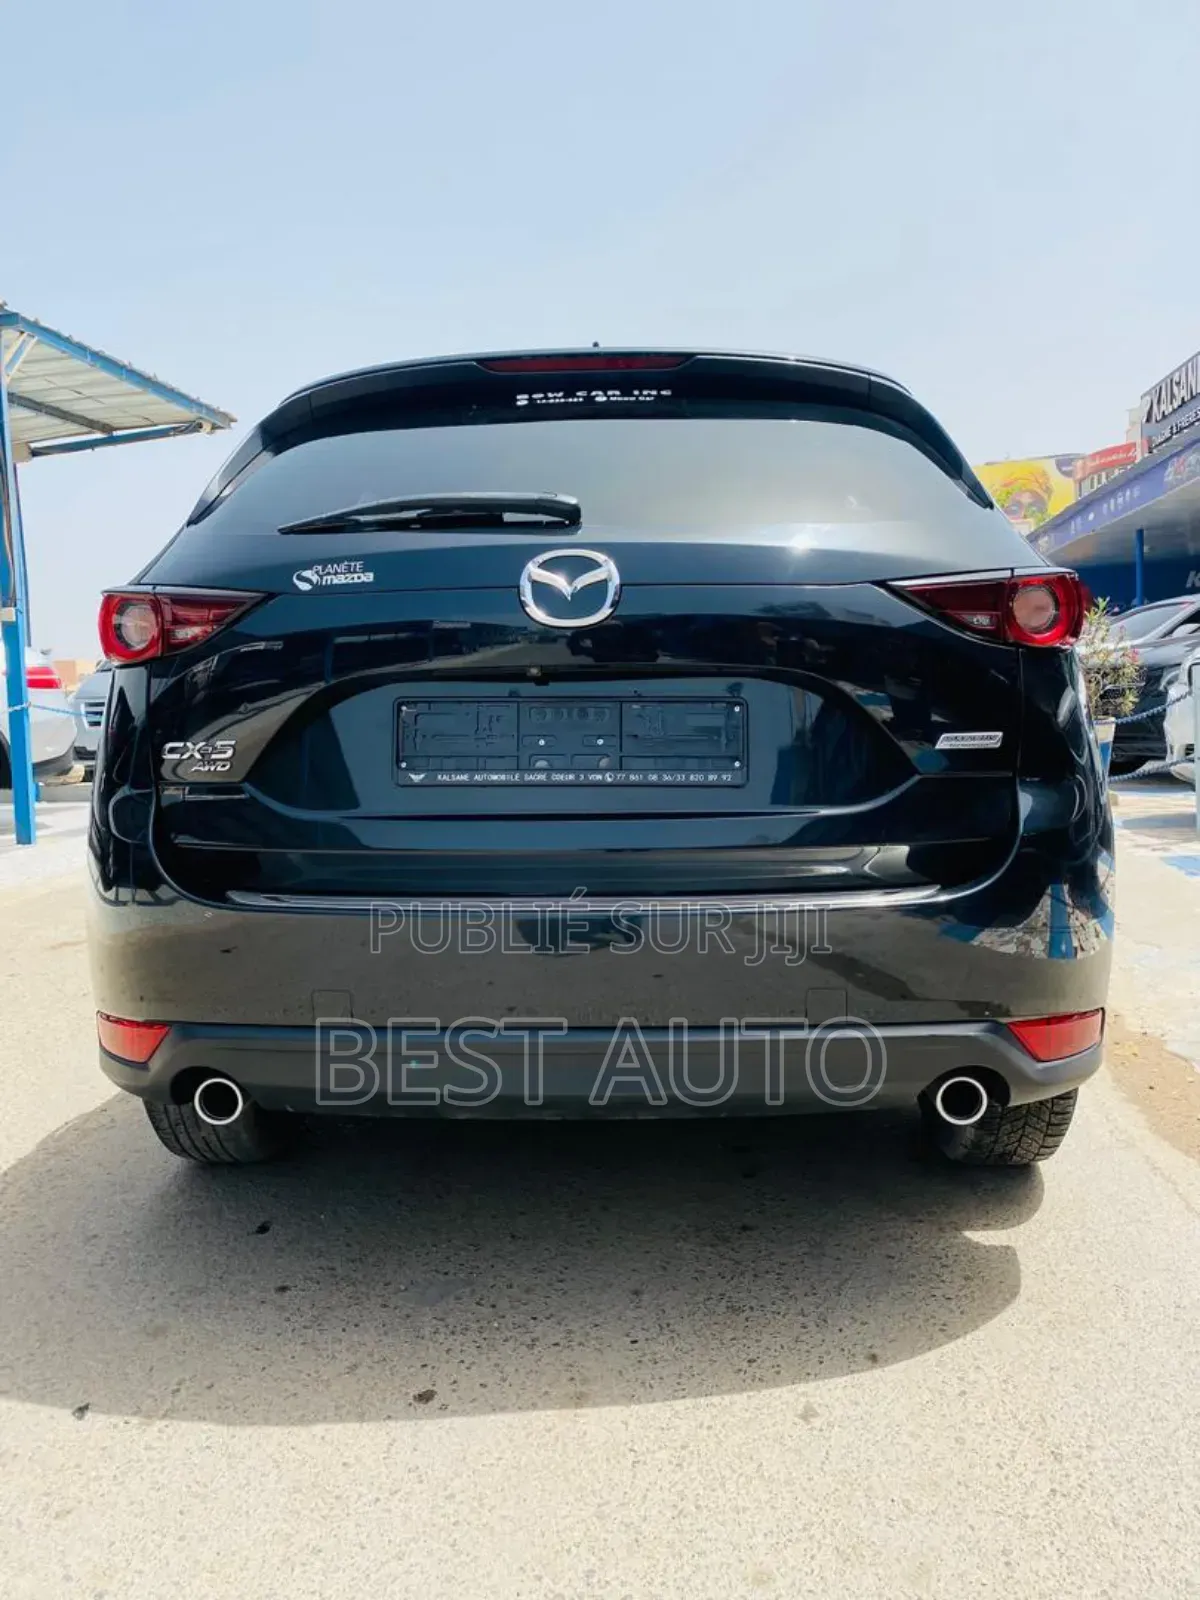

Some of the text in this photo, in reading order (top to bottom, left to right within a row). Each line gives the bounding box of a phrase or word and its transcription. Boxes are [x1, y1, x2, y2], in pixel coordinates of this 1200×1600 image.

[1151, 354, 1200, 424] KALSAN
[162, 740, 236, 759] CX-5
[191, 761, 231, 772] AWD
